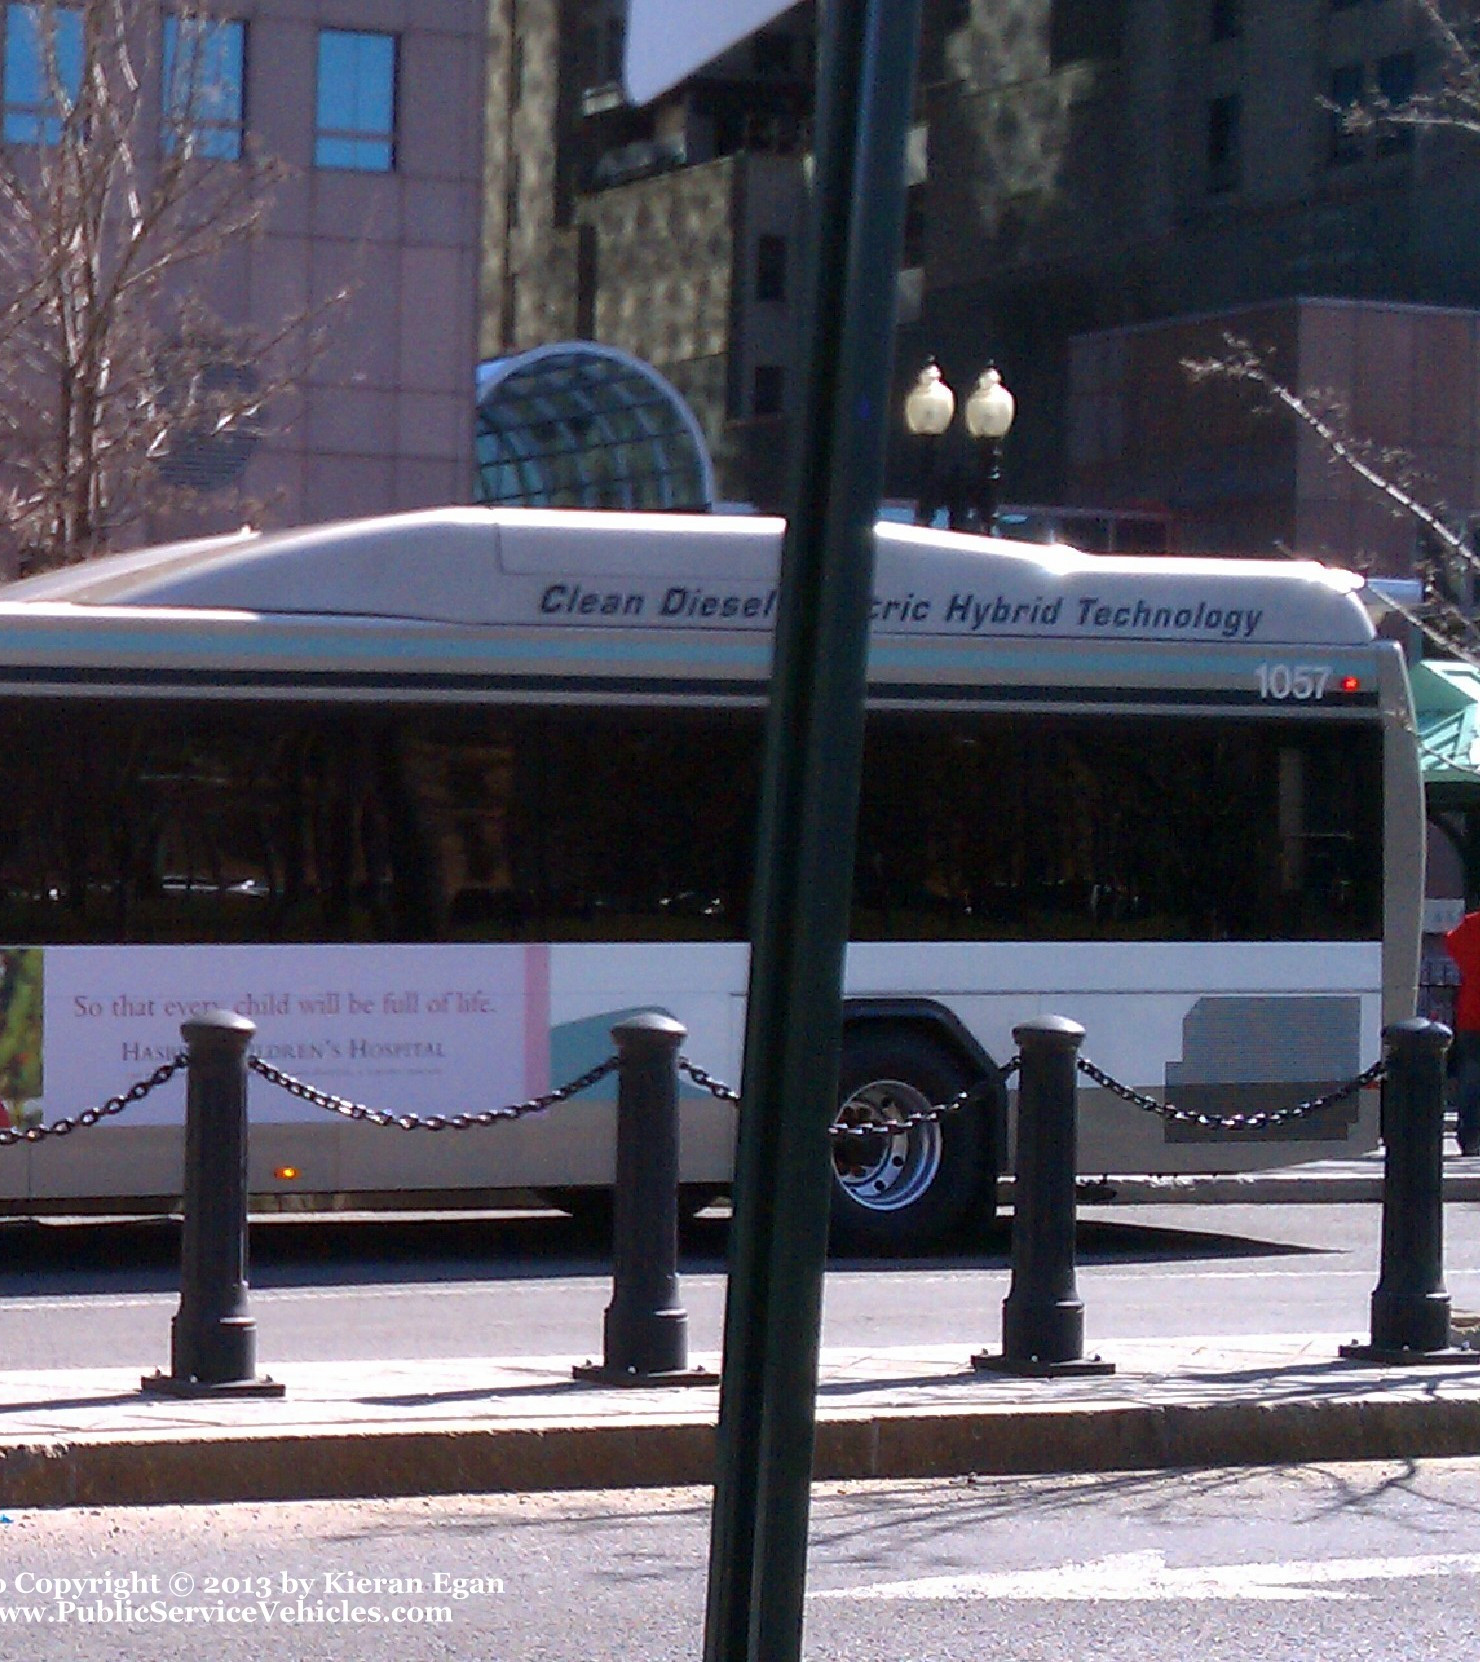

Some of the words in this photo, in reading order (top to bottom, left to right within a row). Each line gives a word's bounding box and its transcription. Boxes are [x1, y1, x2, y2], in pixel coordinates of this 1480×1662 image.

[539, 584, 644, 616] Clean
[658, 587, 777, 619] Diesel
[945, 593, 1064, 631] Hybrid
[1077, 596, 1263, 638] Technology
[1255, 663, 1333, 700] 1057
[74, 996, 103, 1018] So
[112, 993, 154, 1017] that
[232, 993, 289, 1017] child
[298, 992, 340, 1016] will
[348, 992, 373, 1014] be
[383, 992, 418, 1014] full
[426, 991, 453, 1013] of
[456, 989, 497, 1013] life.
[122, 1041, 189, 1062] HASB
[349, 1038, 445, 1059] HOSPITAL
